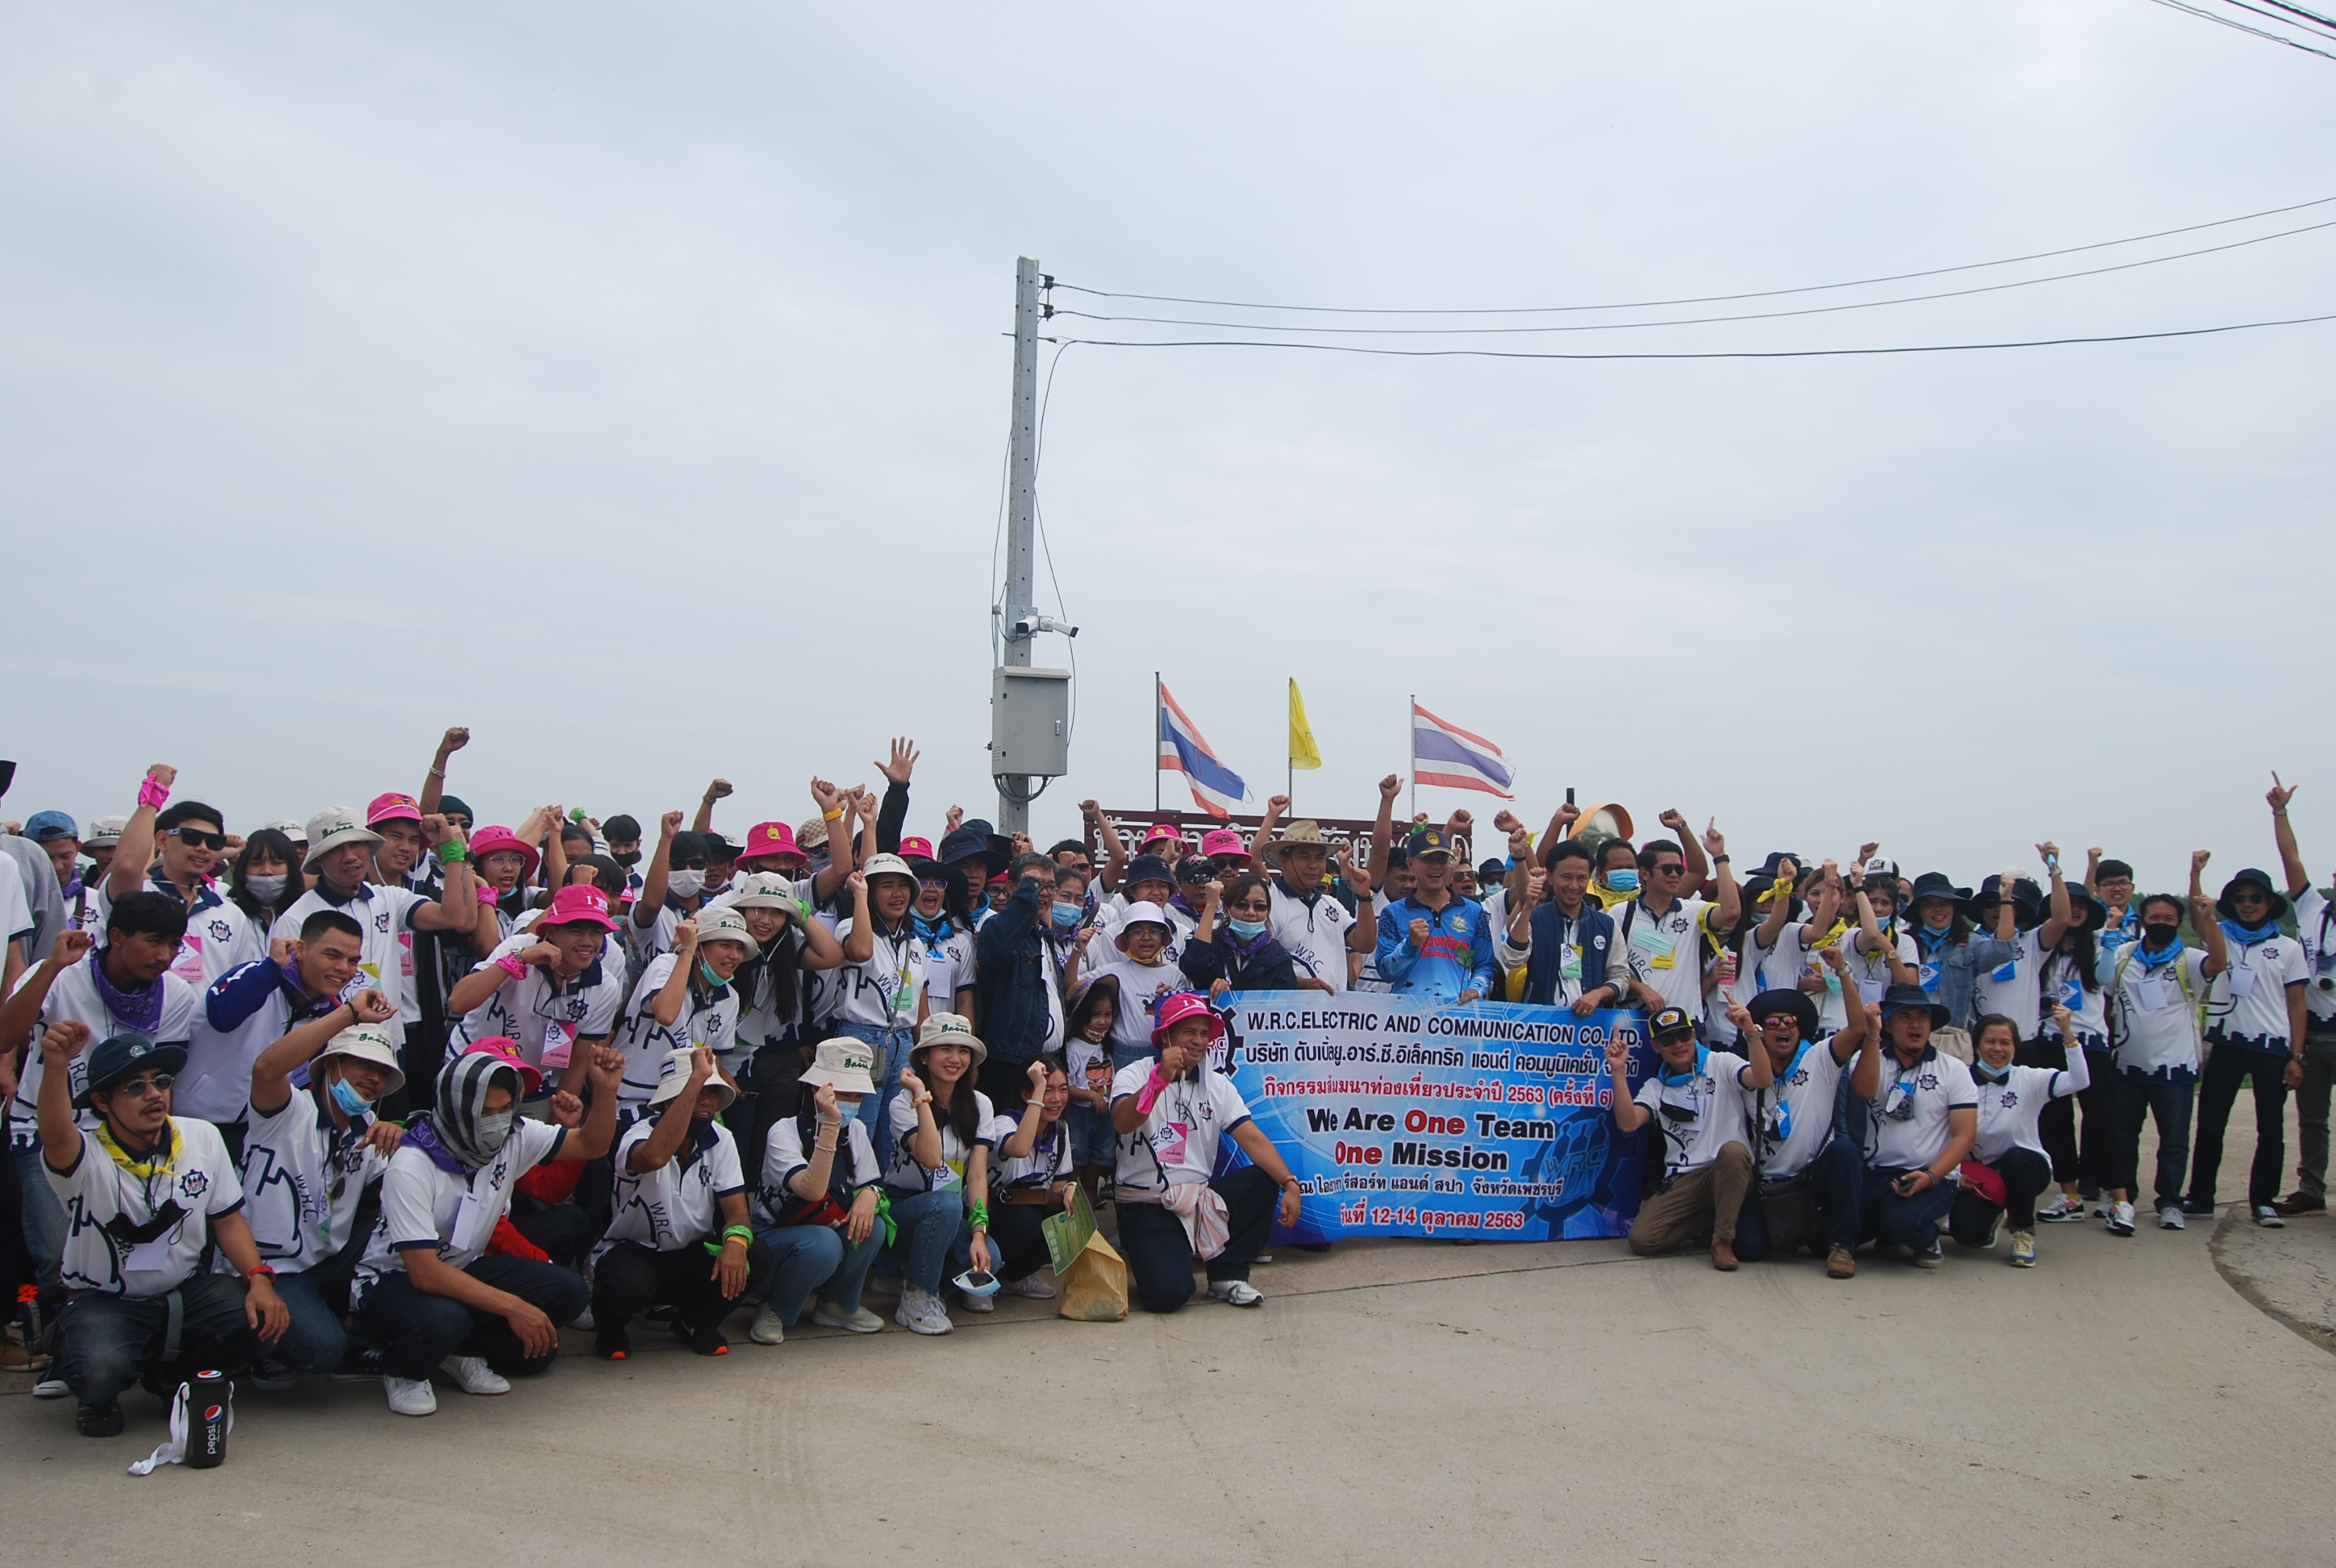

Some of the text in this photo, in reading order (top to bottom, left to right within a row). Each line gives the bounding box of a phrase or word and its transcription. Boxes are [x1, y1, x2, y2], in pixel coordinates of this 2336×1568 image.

[1295, 943, 1324, 974] W.R.C.
[1627, 949, 1653, 980] W.R.C.
[1247, 1011, 1379, 1032] W.R.C.ELECTRIC
[1383, 1015, 1421, 1034] AND
[1428, 1017, 1574, 1044] COMMUNICATION
[1245, 1040, 1289, 1063] บริษัท
[1471, 1049, 1510, 1070] แอนด์
[1514, 1050, 1599, 1078] คอมมูนิเคชั่น
[1508, 1086, 1545, 1103] 2563
[1549, 1078, 1595, 1107] (ครั้งที่
[1600, 1089, 1613, 1110] 6)
[1306, 1107, 1555, 1139] We Are One Team
[1335, 1141, 1508, 1170] One Mission
[1544, 1145, 1606, 1174] WRC
[1344, 1171, 1387, 1190] รีสอร์ท
[1391, 1174, 1429, 1191] แอนด์
[1434, 1178, 1463, 1193] สปา
[1472, 1177, 1563, 1202] จังหวัดเพชรบุรี
[1371, 1208, 1416, 1224] 12-14
[1422, 1210, 1479, 1234] ตุลาคม
[1485, 1212, 1524, 1228] 2563
[206, 1424, 217, 1455] pepsi
